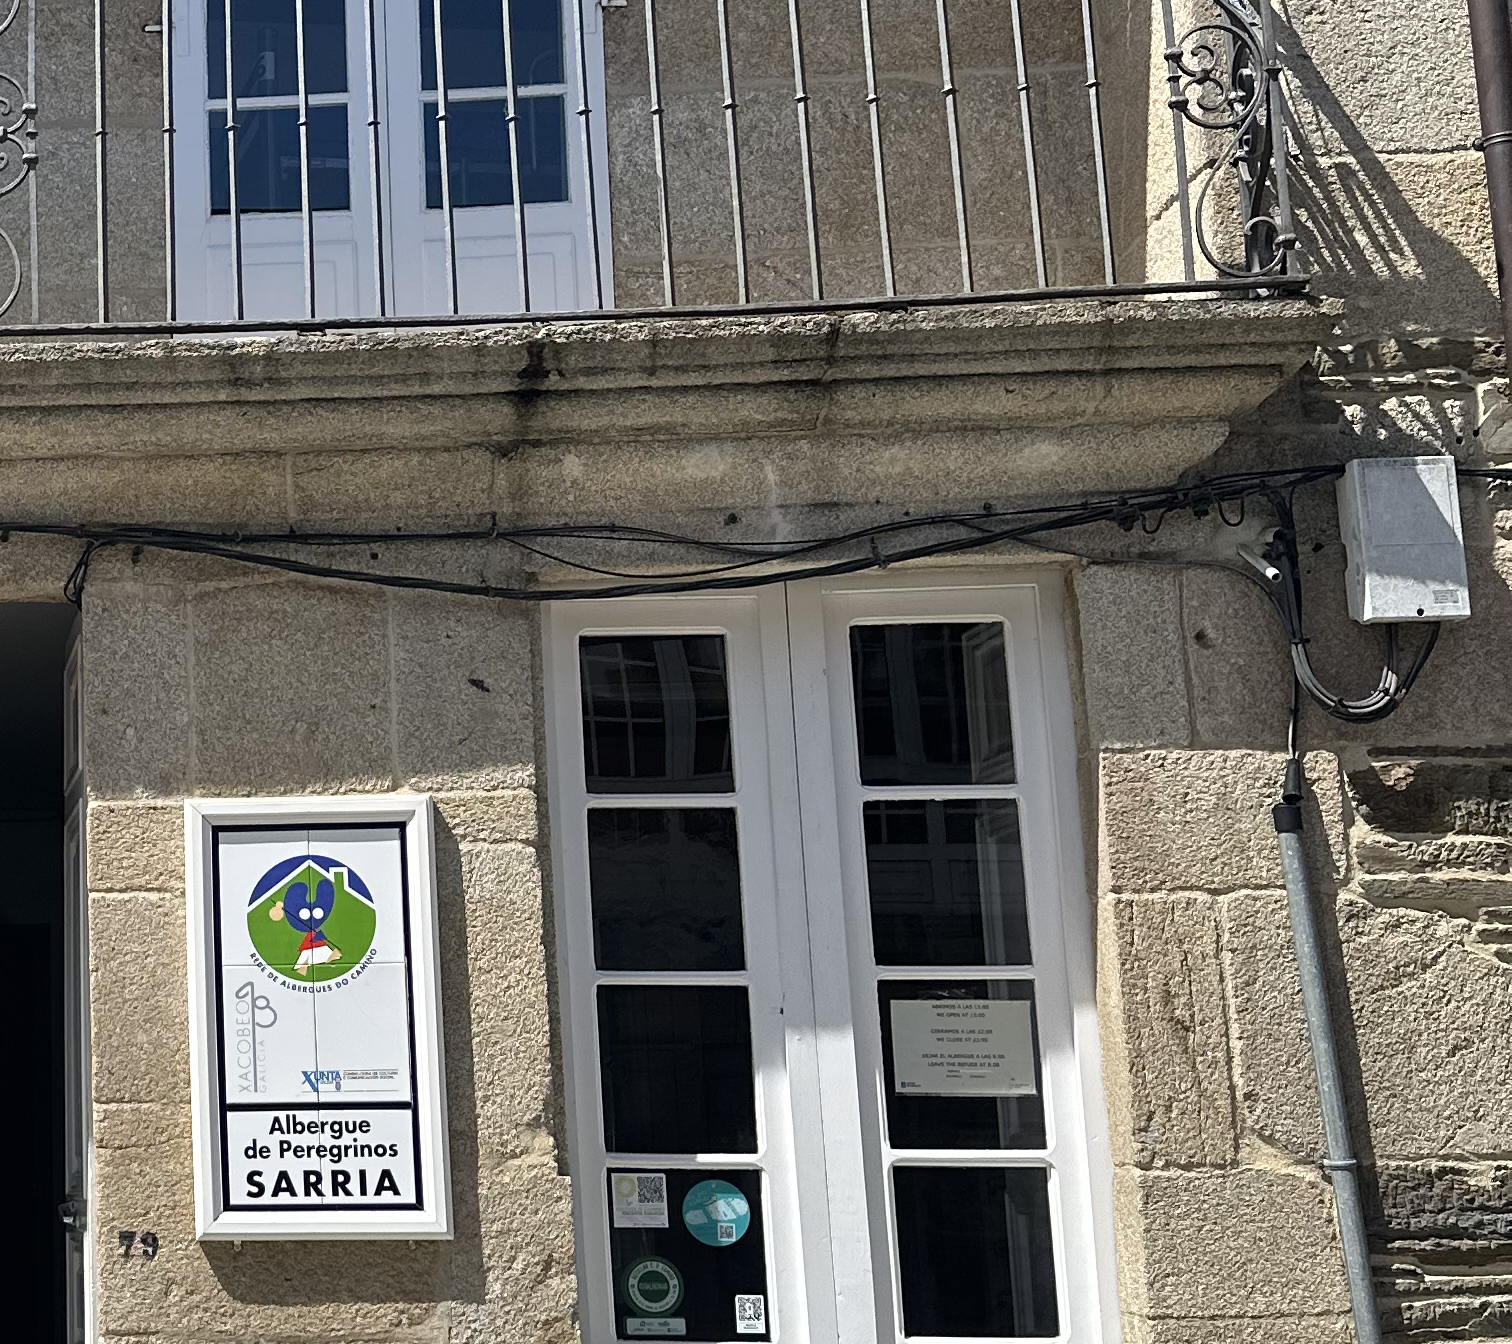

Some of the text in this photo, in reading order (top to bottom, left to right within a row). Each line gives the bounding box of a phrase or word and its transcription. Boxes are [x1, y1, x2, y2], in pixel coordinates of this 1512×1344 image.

[249, 952, 267, 973] REDE
[267, 971, 279, 983] DE
[279, 980, 333, 994] ALBERGUES
[335, 978, 349, 989] DO
[235, 999, 253, 1093] XACOBEO
[257, 1039, 267, 1094] GALICIA
[301, 1070, 343, 1093] XUNTA
[268, 1113, 371, 1140] Albergue
[243, 1137, 399, 1164] de Peregrinos
[246, 1168, 402, 1199] SARRIA
[118, 1230, 159, 1262] 79
